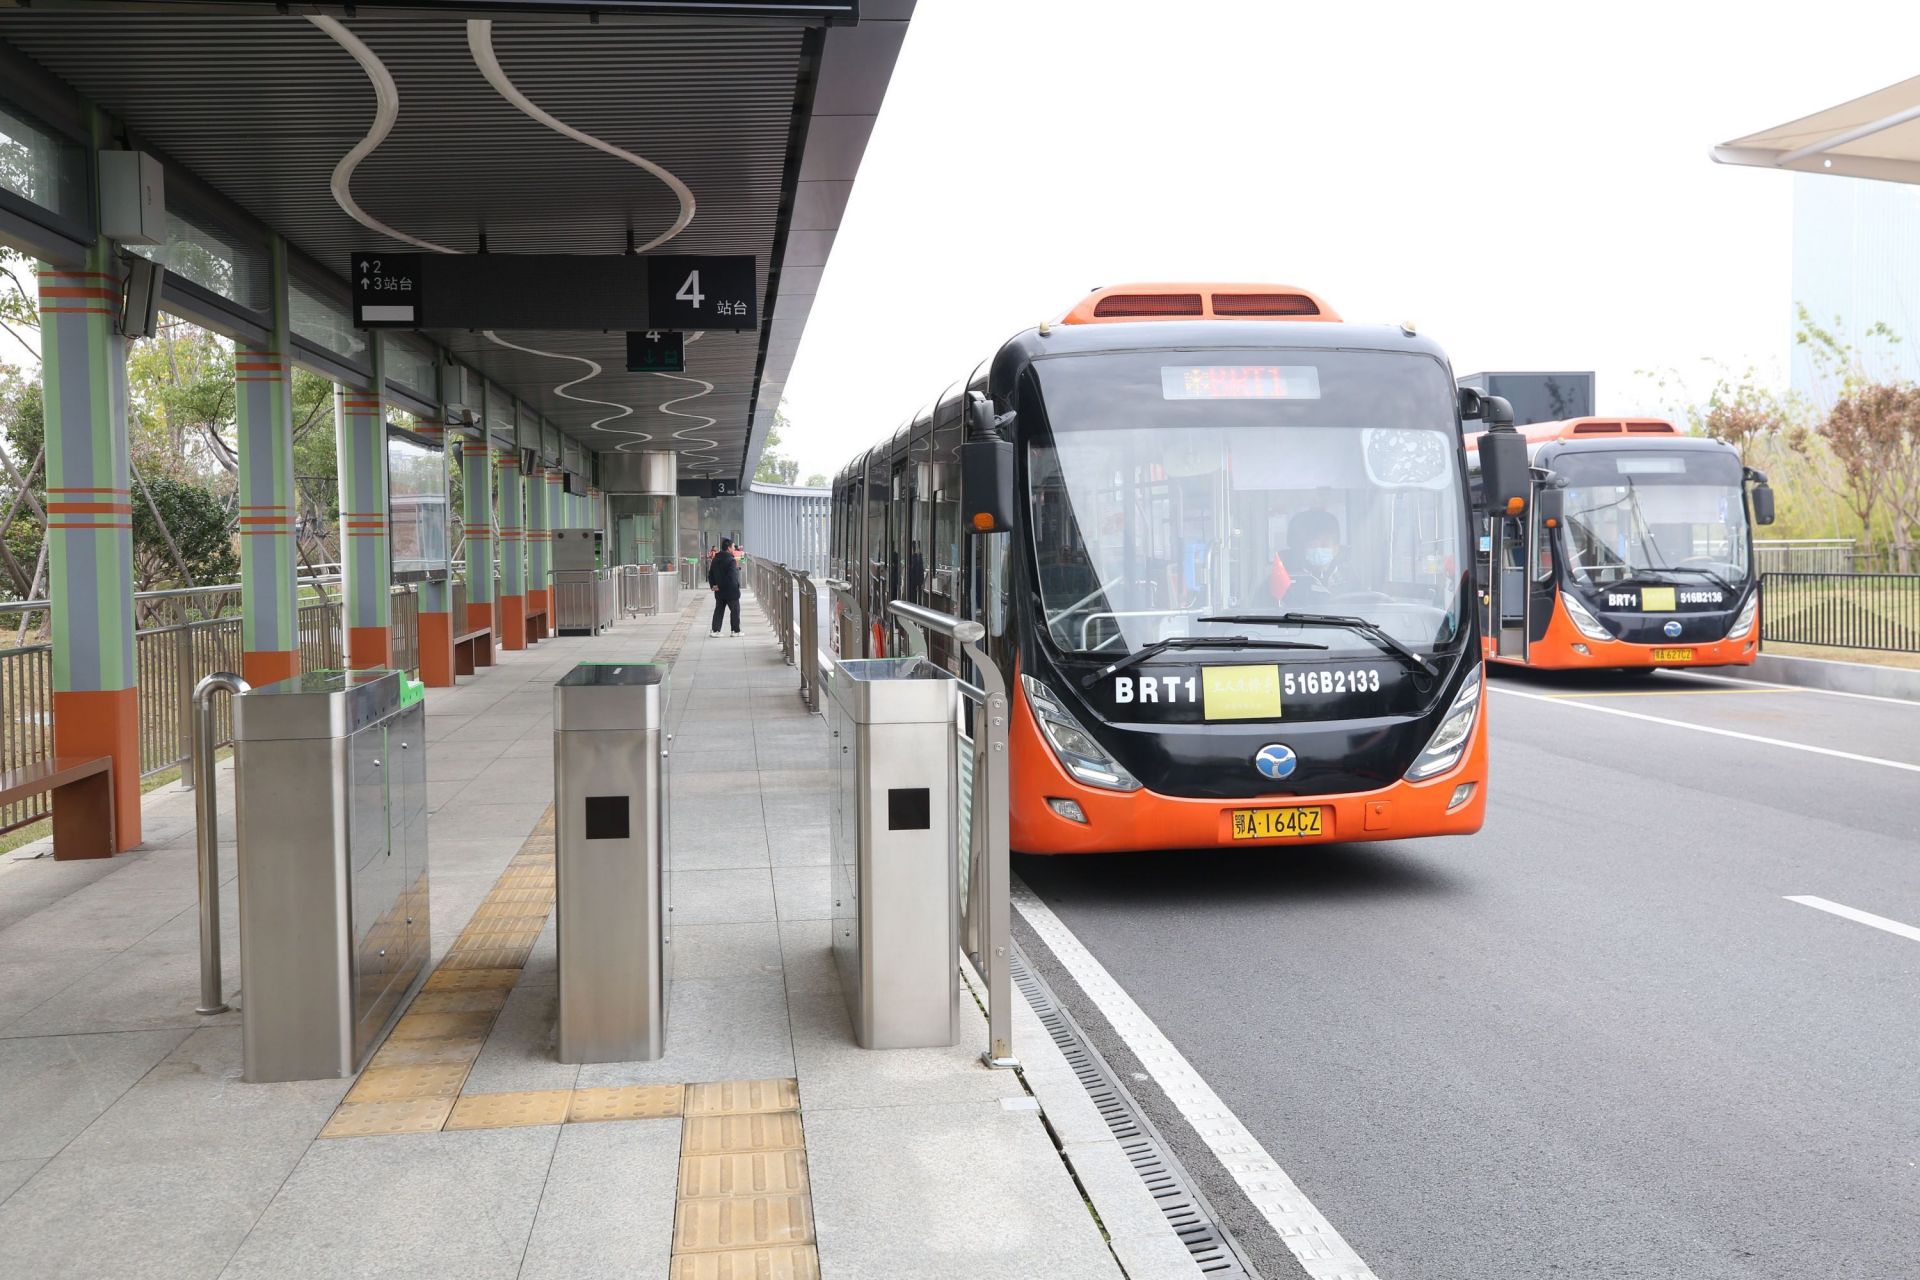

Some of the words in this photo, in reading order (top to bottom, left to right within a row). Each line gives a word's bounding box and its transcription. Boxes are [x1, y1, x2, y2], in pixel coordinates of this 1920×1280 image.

[372, 260, 382, 274] 2
[675, 269, 706, 309] 4
[716, 299, 748, 316] 站台
[645, 330, 662, 343] 4
[718, 482, 726, 493] 3
[1608, 594, 1637, 607] BRT1
[1115, 676, 1196, 704] BRT1
[1284, 669, 1380, 695] 516B2133
